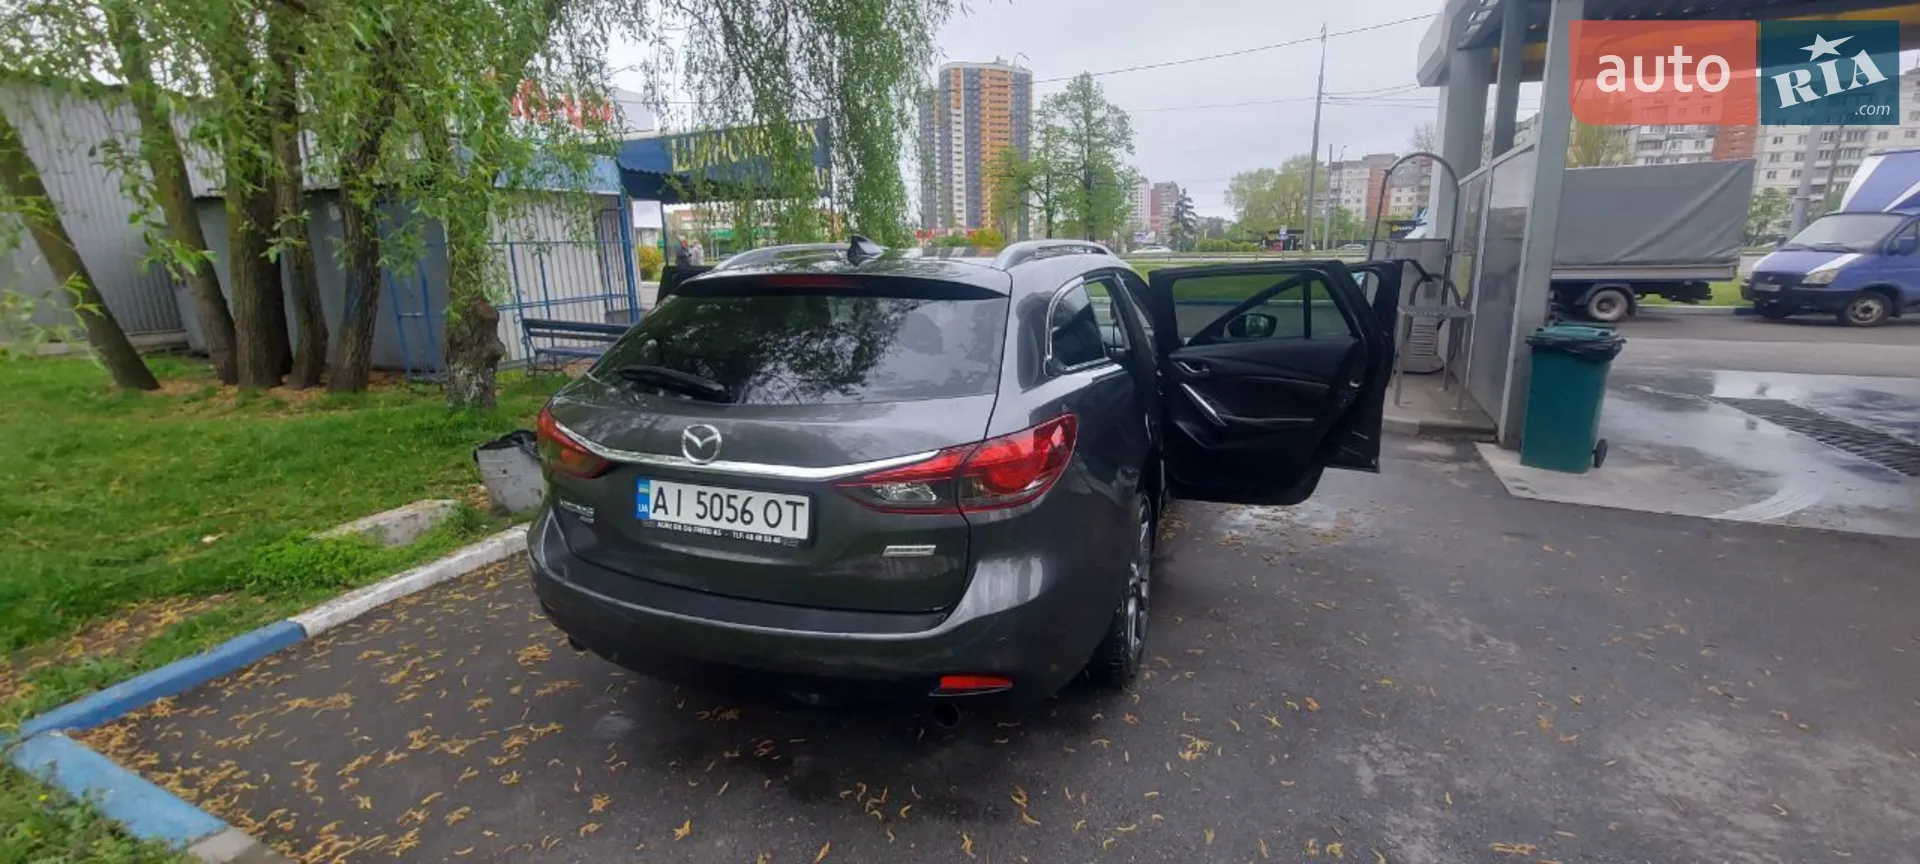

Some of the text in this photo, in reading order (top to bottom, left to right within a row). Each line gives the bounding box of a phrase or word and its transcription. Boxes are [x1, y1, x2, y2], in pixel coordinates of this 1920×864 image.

[638, 503, 649, 514] UA
[695, 490, 754, 526] 5056
[763, 499, 805, 532] OT
